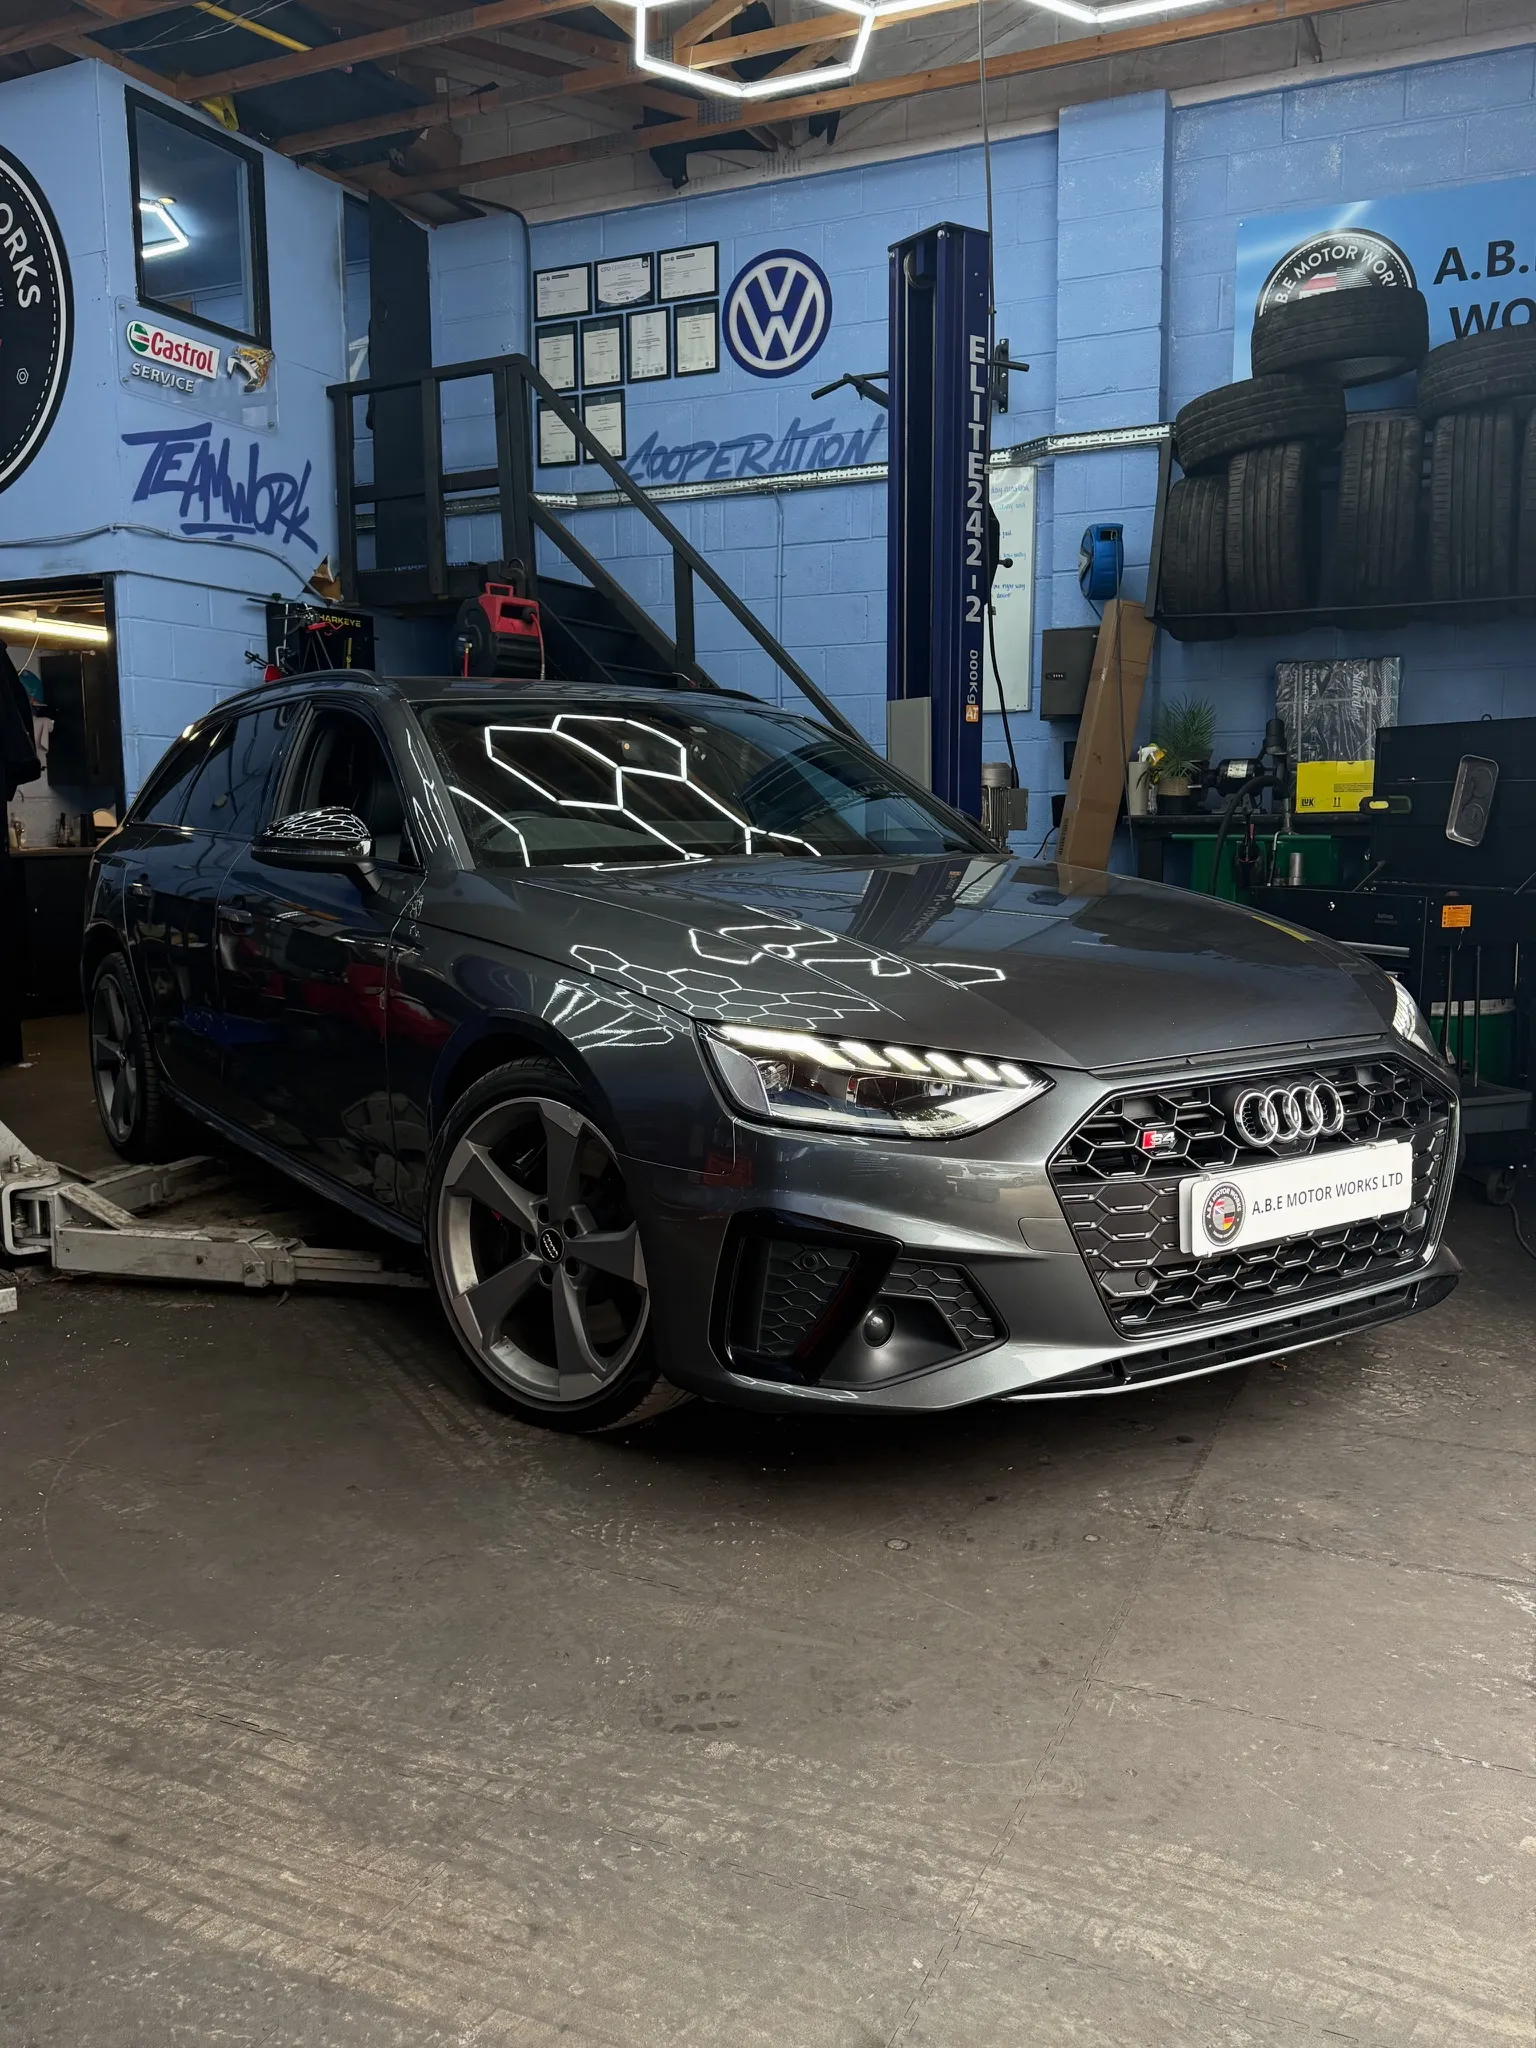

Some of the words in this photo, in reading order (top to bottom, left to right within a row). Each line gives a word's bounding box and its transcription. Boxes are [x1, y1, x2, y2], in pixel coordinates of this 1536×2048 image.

[1294, 245, 1358, 279] MOTOR
[1433, 240, 1536, 285] A.B.
[150, 331, 214, 374] Castrol
[131, 362, 195, 393] SERVICE
[622, 413, 886, 483] COOPERATION
[121, 422, 319, 553] TEAMWORK
[1251, 1195, 1283, 1216] A.B.E
[1286, 1186, 1332, 1208] MOTOR
[1335, 1176, 1378, 1198] WORKS
[1382, 1172, 1403, 1188] LTD
